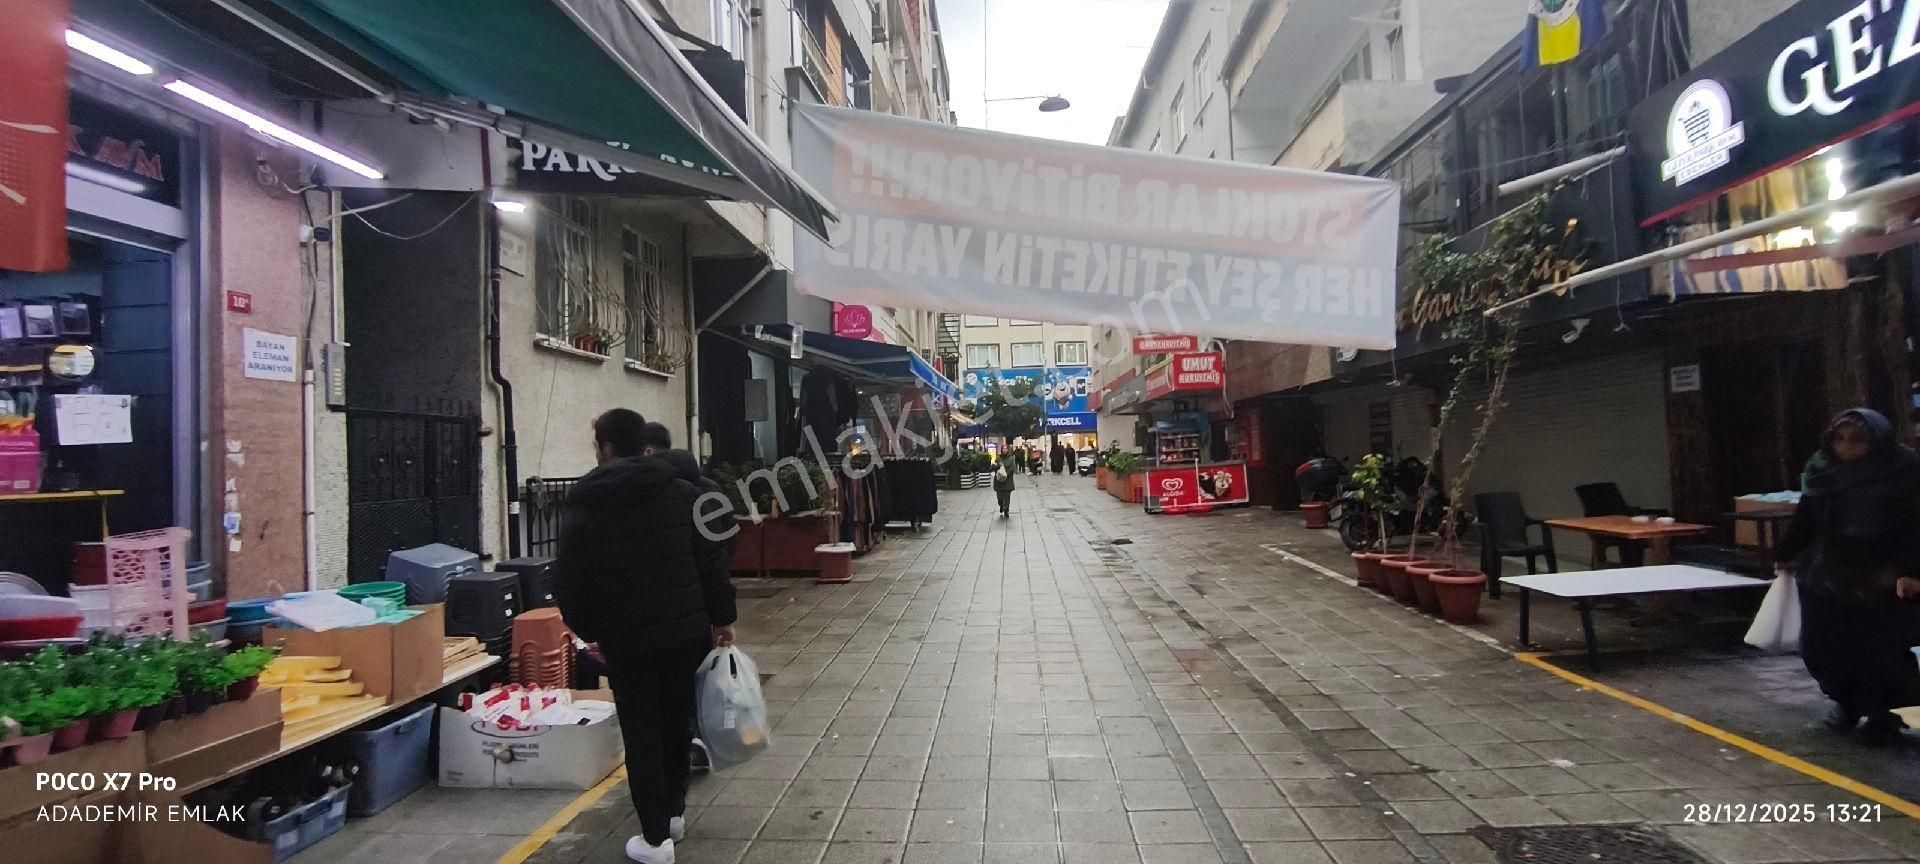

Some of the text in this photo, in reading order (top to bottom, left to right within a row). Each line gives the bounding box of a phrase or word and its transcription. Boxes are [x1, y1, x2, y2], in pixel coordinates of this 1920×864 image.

[256, 340, 285, 351] BAYAN
[252, 351, 289, 362] ELEMAN
[247, 361, 293, 374] ARANIYOR
[1182, 357, 1216, 371] UMUT
